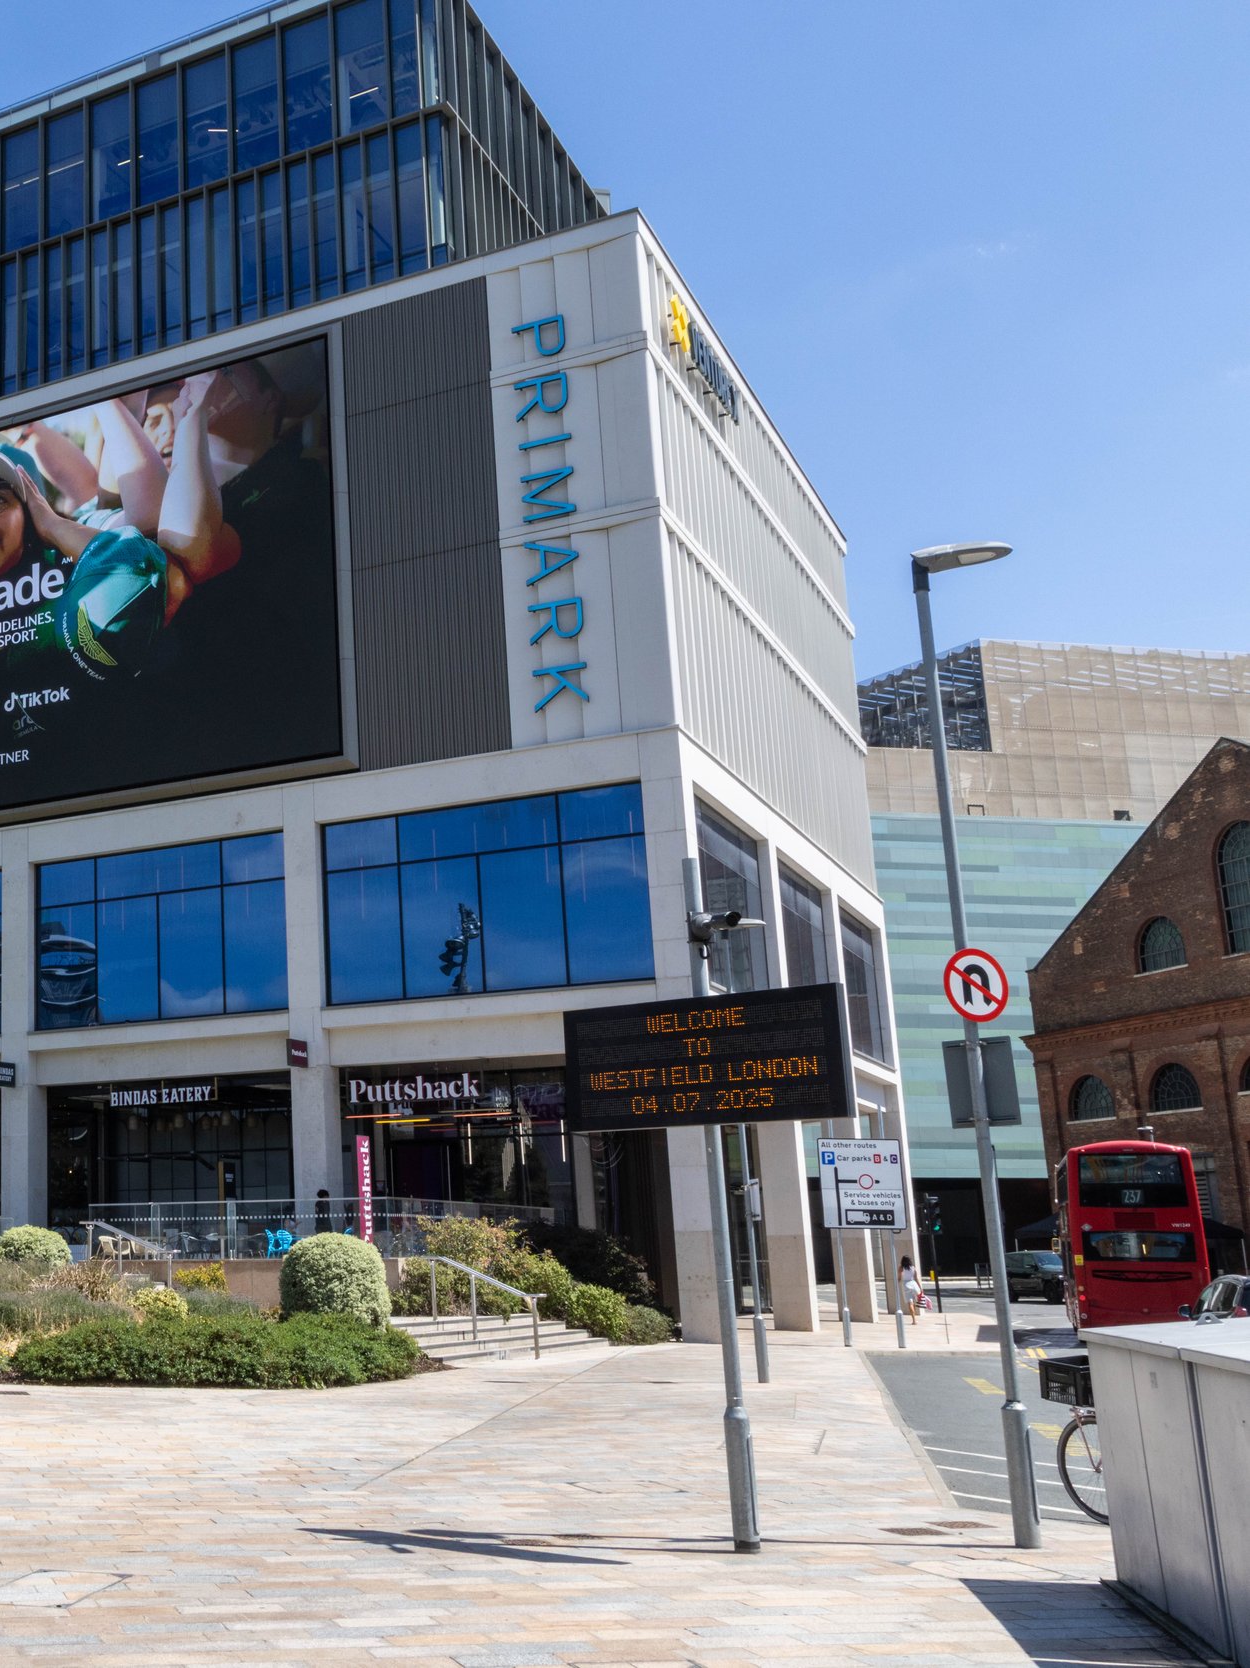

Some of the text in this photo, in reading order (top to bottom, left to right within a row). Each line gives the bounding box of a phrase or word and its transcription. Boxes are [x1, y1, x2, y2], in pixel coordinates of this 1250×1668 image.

[511, 314, 590, 714] PRIMARK
[20, 686, 70, 709] TikTok
[646, 1006, 745, 1034] WELCOME
[683, 1037, 711, 1057] TO
[590, 1055, 819, 1091] WESTFIELD LONDON
[110, 1086, 211, 1107] BINDAS EATERY
[349, 1073, 479, 1103] Puttshack
[631, 1087, 774, 1115] 04.07.2025
[890, 1155, 897, 1163] C
[872, 1191, 901, 1199] vehicles
[1123, 1190, 1141, 1203] 237
